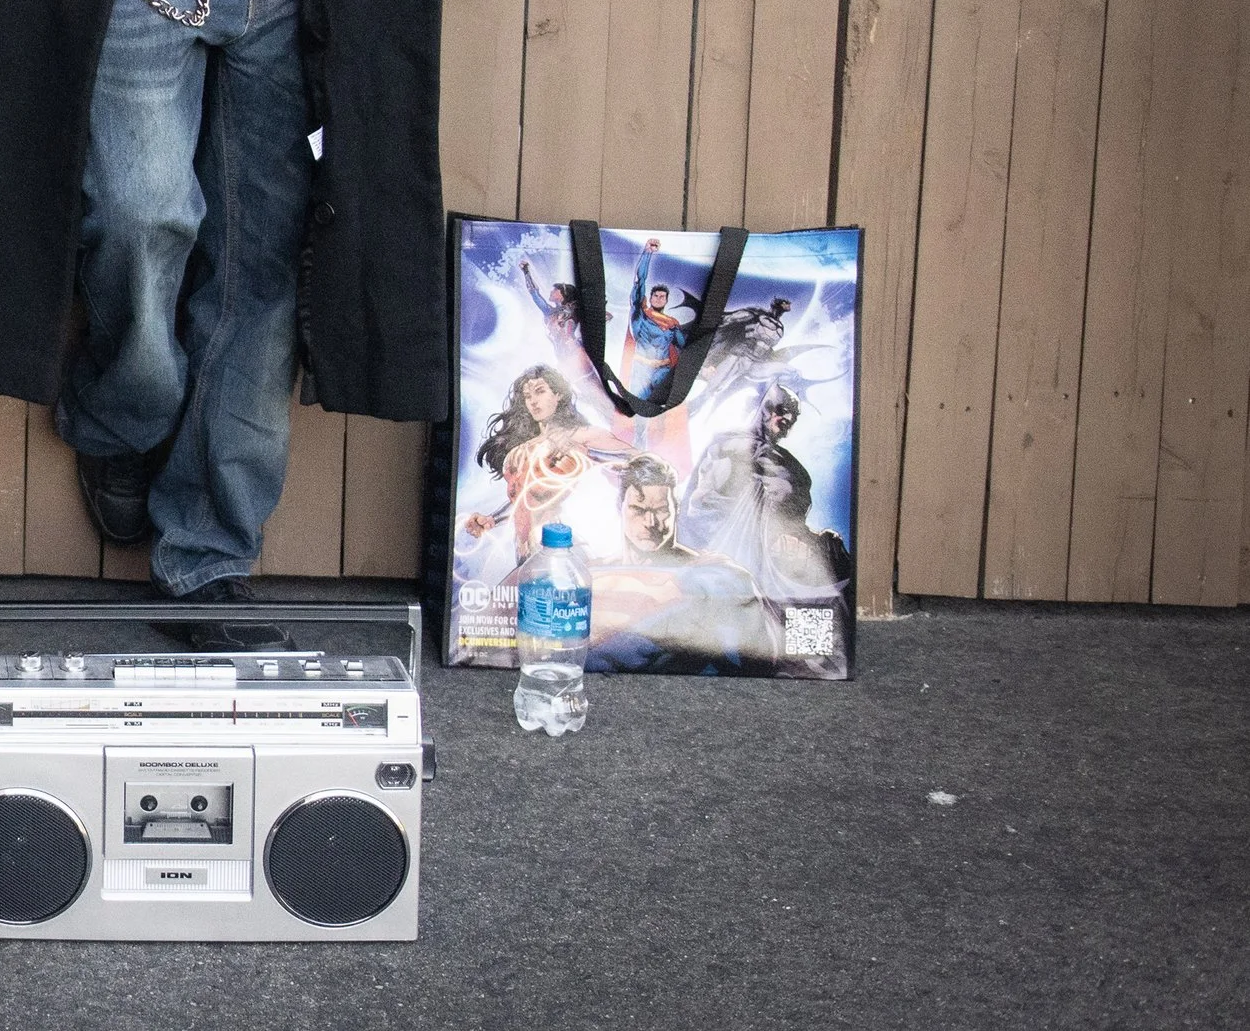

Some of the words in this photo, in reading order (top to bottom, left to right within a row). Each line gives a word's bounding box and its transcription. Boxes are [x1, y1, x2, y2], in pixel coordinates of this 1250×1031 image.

[461, 587, 488, 606] DC
[458, 615, 475, 624] JOIN
[476, 615, 493, 625] NOW
[494, 616, 508, 625] FOR
[458, 625, 499, 636] EXCLUSIVES
[500, 627, 515, 636] AND
